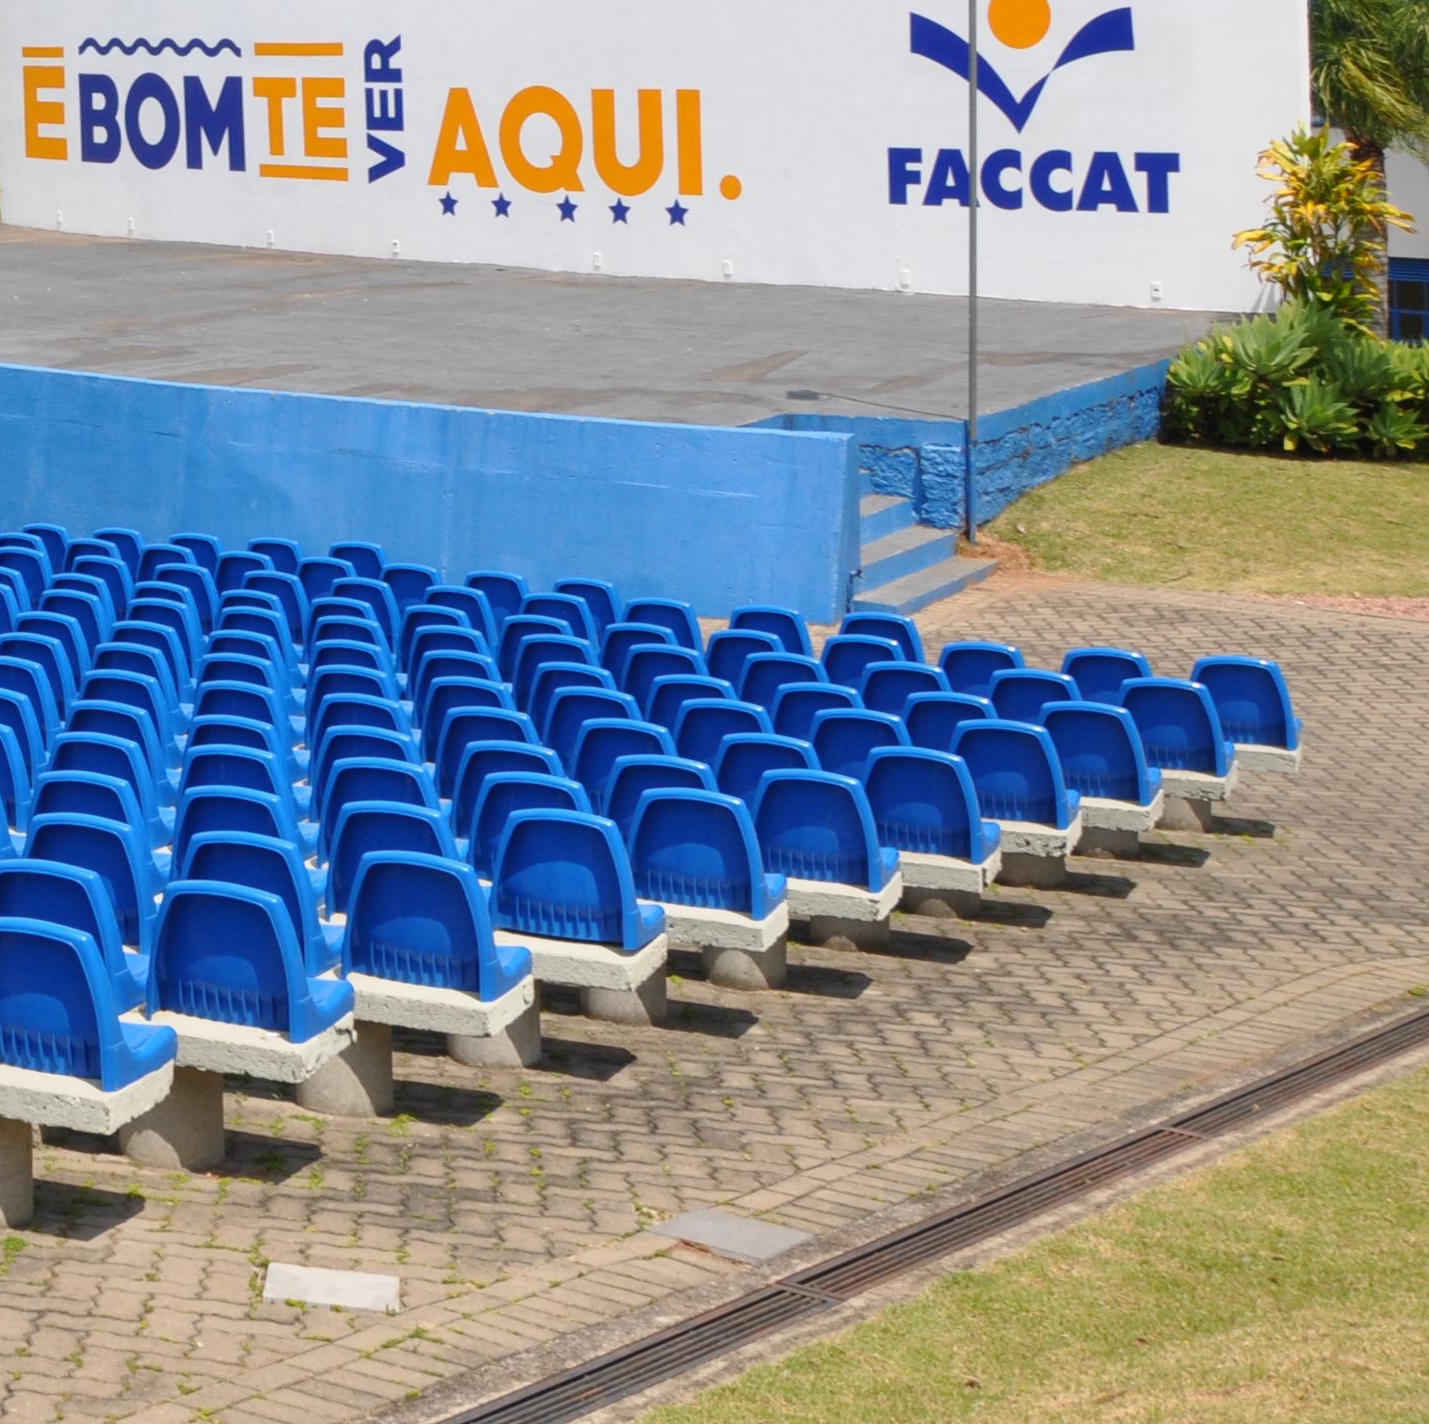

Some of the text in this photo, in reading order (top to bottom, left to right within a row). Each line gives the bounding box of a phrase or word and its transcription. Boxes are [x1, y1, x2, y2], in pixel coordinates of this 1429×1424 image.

[78, 72, 246, 172] BOM
[252, 76, 348, 159] TE
[363, 34, 405, 184] VER
[427, 85, 742, 200] AQUI.
[887, 147, 1180, 214] FACCAT
